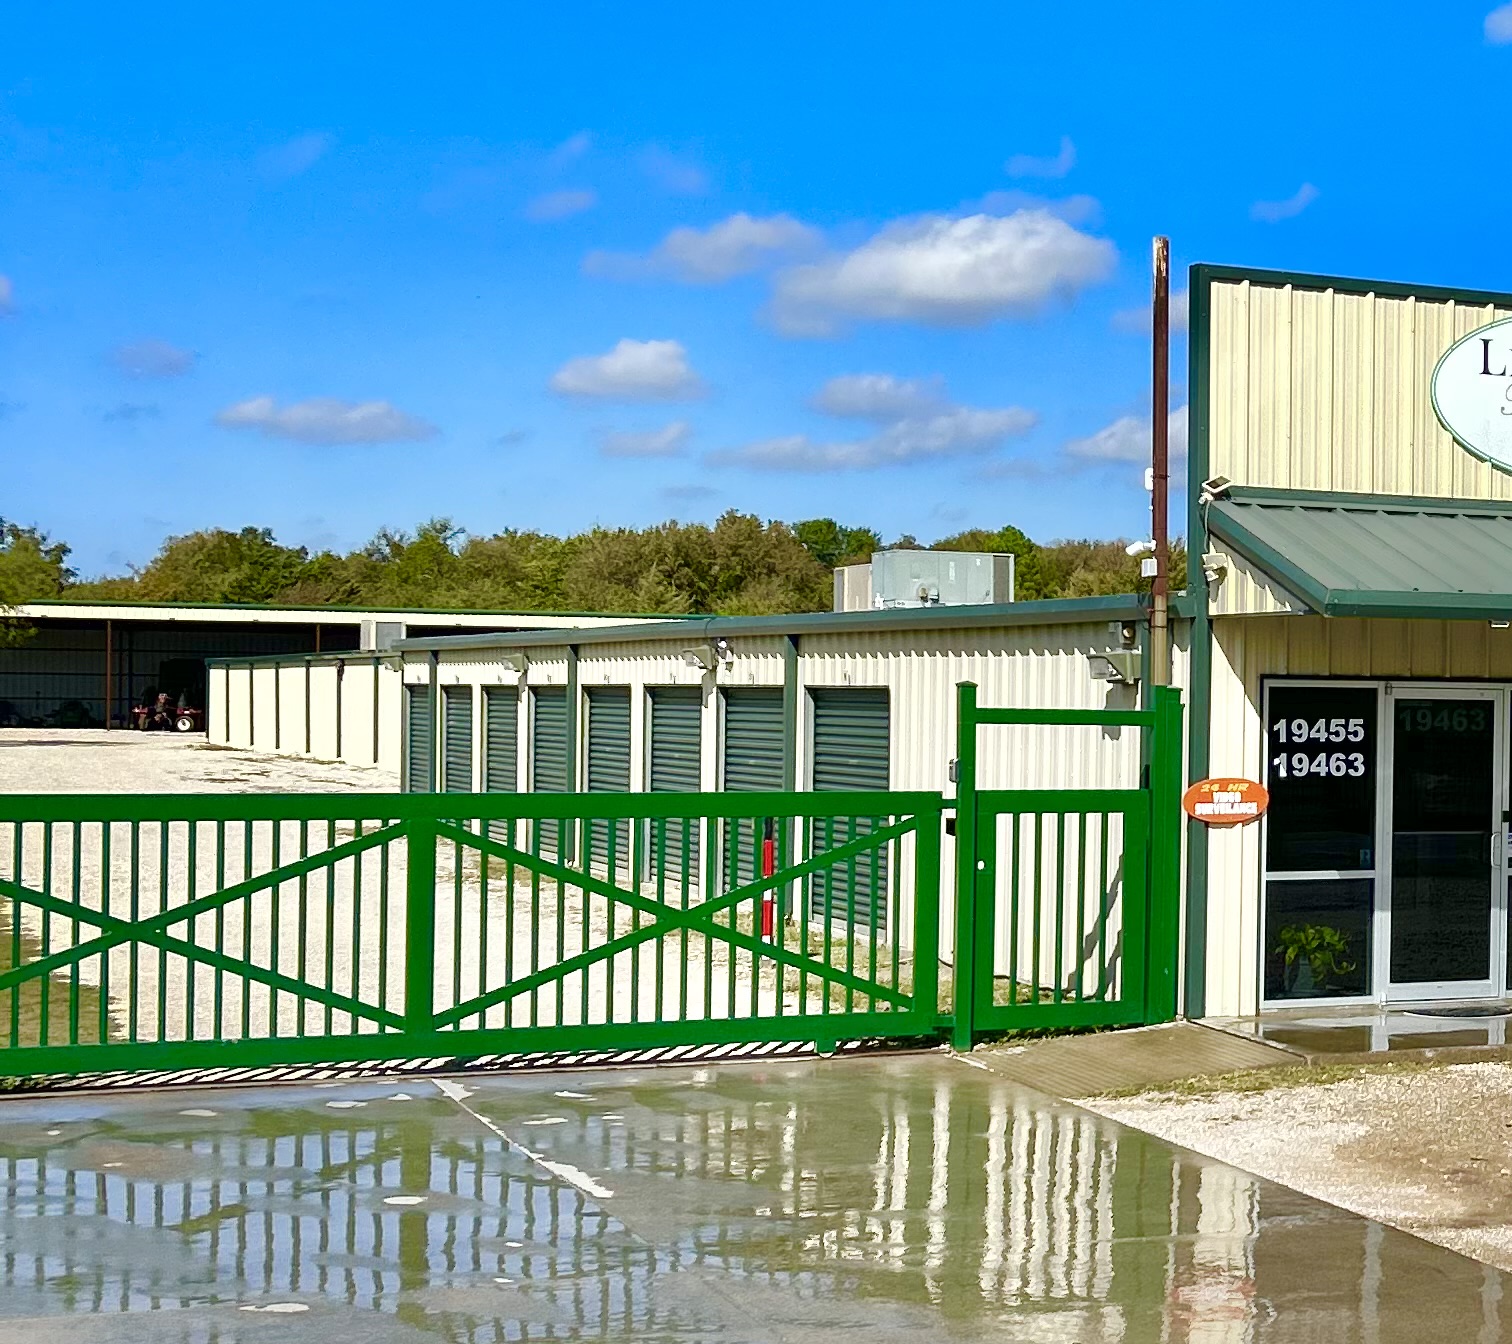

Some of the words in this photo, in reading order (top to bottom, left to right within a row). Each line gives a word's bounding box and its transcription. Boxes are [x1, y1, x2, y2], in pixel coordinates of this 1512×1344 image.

[1273, 718, 1365, 743] 19455
[1401, 709, 1486, 733] 19463
[1273, 752, 1366, 777] 19463
[1212, 791, 1242, 803] VIDEO
[1227, 783, 1250, 792] HR
